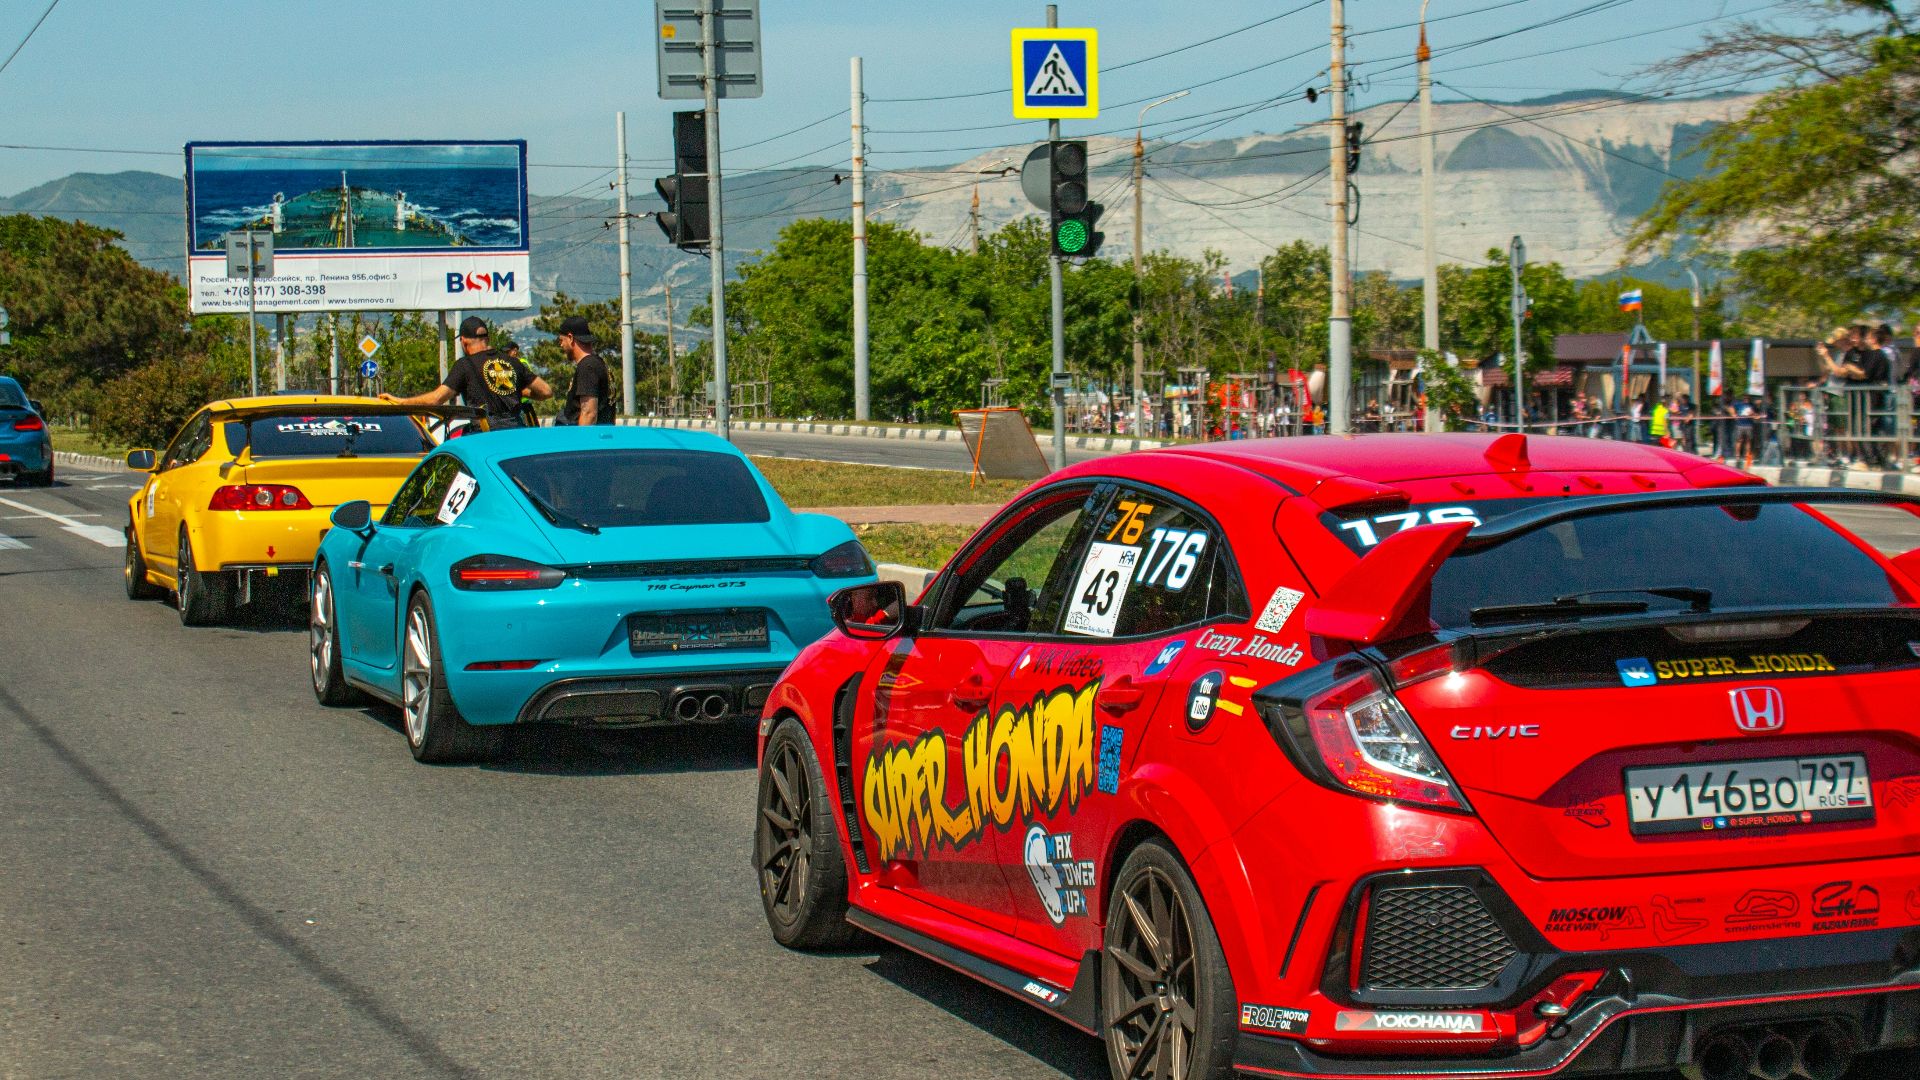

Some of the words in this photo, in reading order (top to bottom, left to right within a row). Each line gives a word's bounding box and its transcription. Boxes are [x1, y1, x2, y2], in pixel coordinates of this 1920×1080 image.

[280, 285, 326, 296] 308-398
[446, 270, 514, 293] BSM
[447, 487, 467, 515] 42
[1106, 500, 1154, 545] 76
[1136, 528, 1207, 590] 176
[669, 583, 715, 592] Cayman
[1081, 568, 1120, 616] 43
[1195, 628, 1304, 667] Crazy_Honda
[1032, 648, 1058, 675] VK
[1056, 649, 1102, 678] Video
[1655, 653, 1836, 680] SUPER_HONDA
[1200, 678, 1214, 694] You
[1193, 700, 1208, 716] Tube
[1450, 724, 1540, 739] CIVIC
[1801, 761, 1855, 796] 797
[1819, 795, 1846, 807] RUS
[1045, 834, 1073, 860] MAX
[1055, 861, 1096, 886] POWER
[1548, 906, 1628, 923] MOSCOW
[1544, 922, 1600, 933] RACEWAY
[1249, 1005, 1283, 1030] ROLF
[1282, 1011, 1309, 1023] MOTOR
[1280, 1020, 1291, 1030] OIL
[1374, 1014, 1475, 1031] YOKOHAMA
